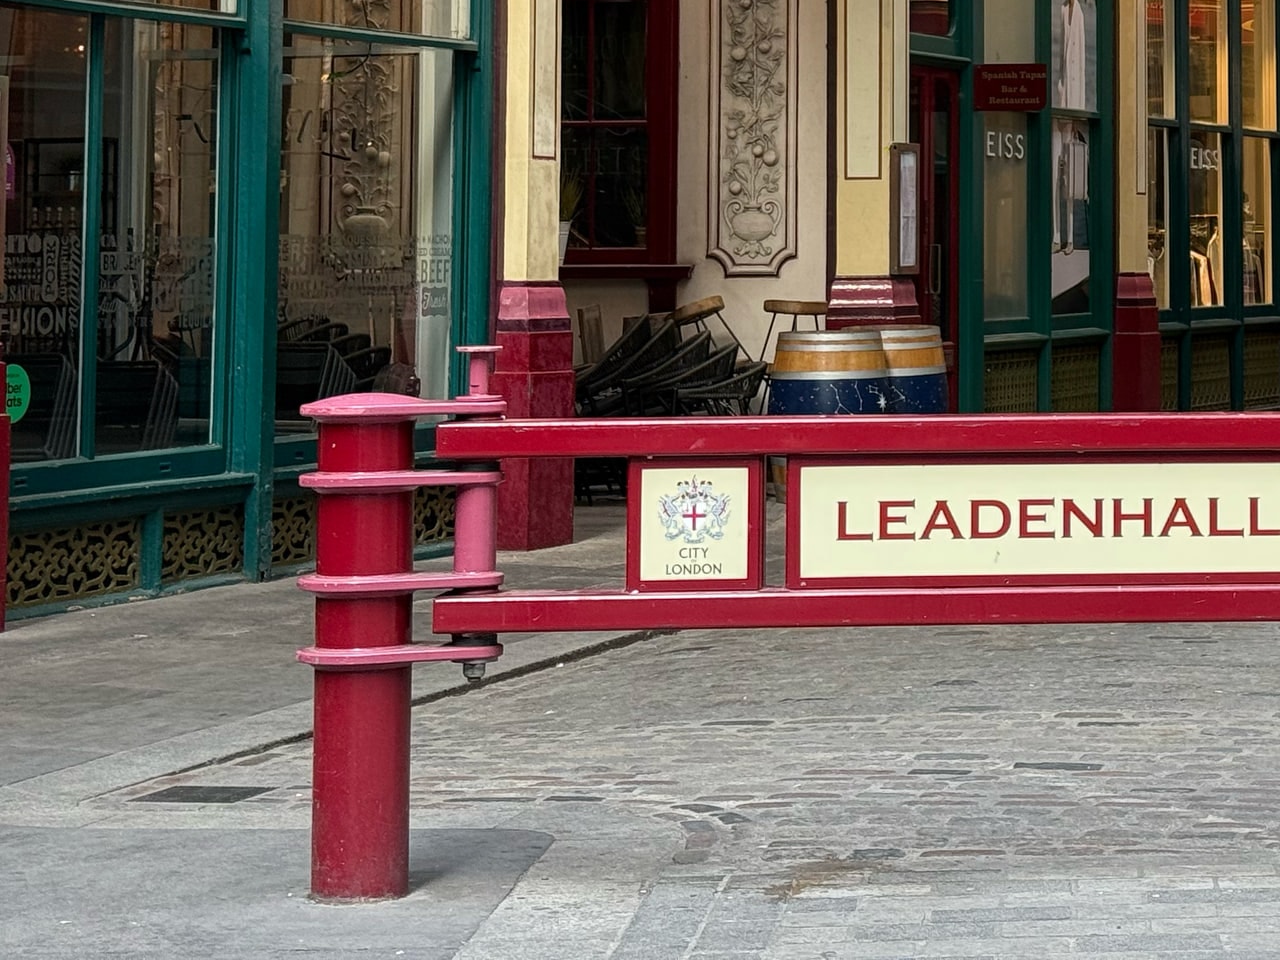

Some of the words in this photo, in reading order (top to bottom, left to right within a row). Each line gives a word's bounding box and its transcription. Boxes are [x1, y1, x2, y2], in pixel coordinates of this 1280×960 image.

[981, 71, 1018, 81] Spanish
[1019, 71, 1046, 81] Tapas
[1001, 85, 1018, 94] Bar
[988, 96, 1041, 105] Restaurant
[986, 131, 1025, 159] EISS
[1191, 147, 1218, 171] EISS
[421, 258, 450, 284] BEEF
[7, 383, 23, 395] ber
[7, 396, 23, 408] ats
[678, 547, 709, 559] CITY
[665, 563, 722, 576] LONDON
